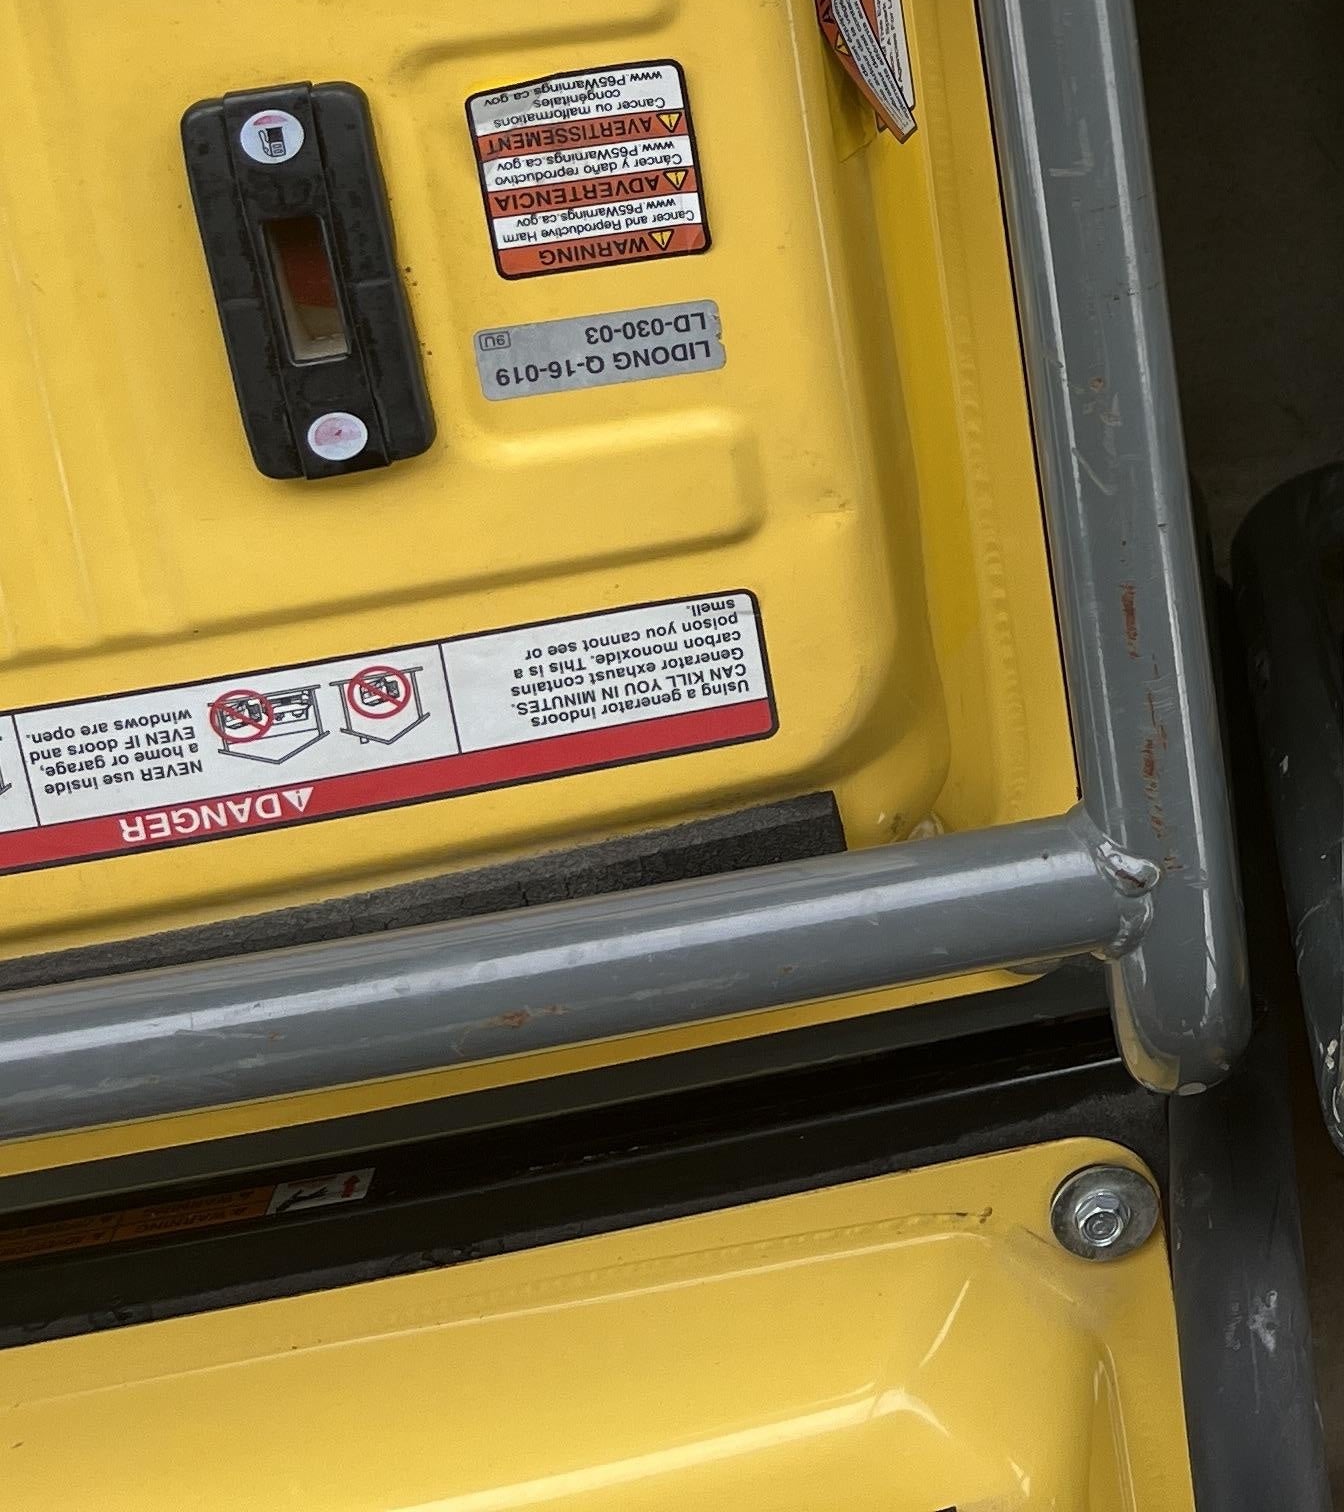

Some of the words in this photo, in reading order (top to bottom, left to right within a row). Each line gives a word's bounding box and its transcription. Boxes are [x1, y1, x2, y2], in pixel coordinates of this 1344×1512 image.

[488, 116, 652, 154] AVERTISSEMENT
[495, 175, 659, 211] ADVERTENCIA
[540, 238, 649, 265] WARNING
[585, 312, 706, 344] LD-030-03
[614, 340, 710, 369] LIDONG
[496, 354, 605, 386] Q-16-019
[687, 599, 735, 616] smell.
[647, 621, 676, 639] you
[682, 612, 738, 631] poison
[548, 642, 577, 655] see
[582, 631, 640, 651] cannot
[684, 631, 741, 649] carbon
[526, 648, 542, 660] or
[590, 641, 678, 664] monoxide.
[661, 648, 743, 670] Generator
[514, 668, 523, 679] a
[530, 664, 543, 676] is
[550, 658, 586, 672] This
[590, 662, 656, 682] exhaust
[710, 664, 746, 681] CAN
[512, 675, 584, 696] contains
[625, 679, 659, 694] YOU
[666, 671, 704, 688] KILL
[702, 680, 749, 697] Using
[602, 687, 618, 700] IN
[687, 690, 696, 699] a
[511, 693, 596, 715] MINUTES.
[601, 692, 681, 714] generator
[114, 709, 192, 730] windows
[531, 707, 596, 727] indoors
[26, 727, 74, 744] open.
[81, 723, 108, 735] are
[146, 727, 195, 746] EVEN
[67, 738, 117, 756] doors
[125, 735, 139, 748] IF
[192, 743, 198, 753] a
[31, 746, 62, 763] and
[112, 755, 128, 767] or
[135, 745, 183, 763] home
[41, 758, 105, 777] garage,
[142, 759, 203, 781] NEVER
[45, 774, 98, 796] inside
[103, 770, 134, 784] use
[120, 793, 281, 842] DANGER
